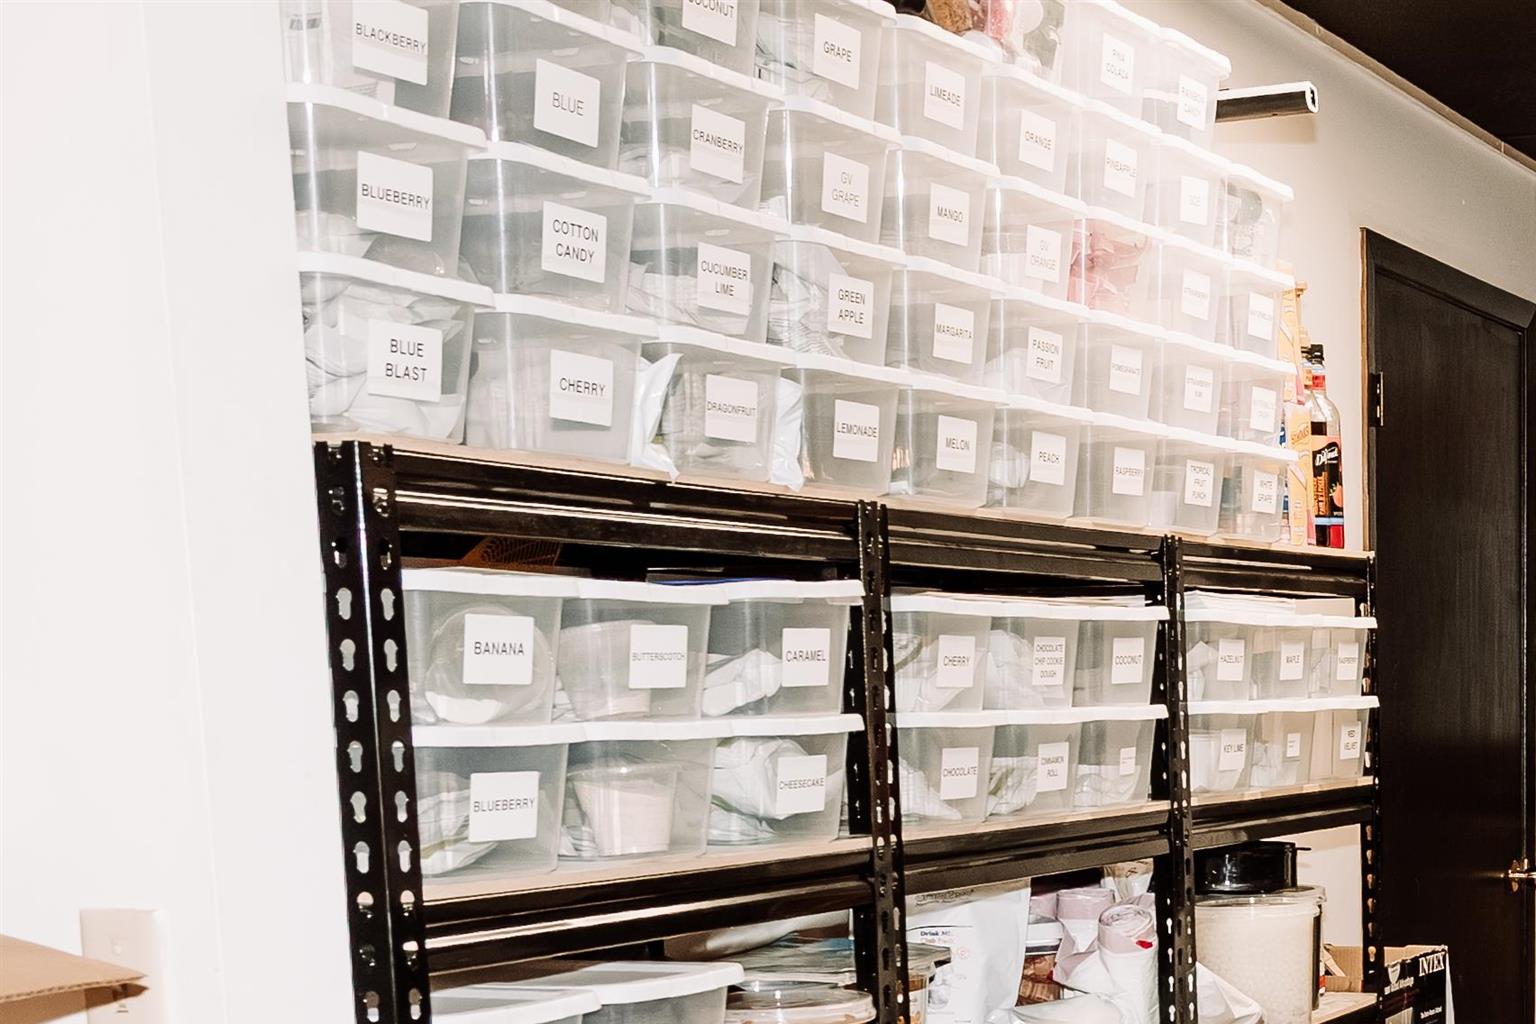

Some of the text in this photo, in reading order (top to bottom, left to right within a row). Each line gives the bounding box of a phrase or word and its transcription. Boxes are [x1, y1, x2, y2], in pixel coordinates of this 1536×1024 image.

[688, 0, 734, 18] CONUT
[355, 22, 426, 53] BLACKBERRY
[824, 41, 852, 63] GRAPE
[930, 84, 961, 107] LIMEADE
[552, 92, 584, 117] BLUE
[693, 129, 743, 153] CRANBERRY
[1025, 131, 1052, 150] ORANGE
[361, 184, 430, 210] BLUEBERRY
[832, 188, 860, 207] GRAPE
[937, 205, 964, 223] MANGO
[552, 218, 599, 242] COTTON
[555, 242, 595, 263] CANDY
[700, 260, 748, 280] CUCUMBER
[715, 282, 735, 297] LIME
[837, 288, 866, 305] GREEN
[838, 307, 865, 325] APPLE
[936, 323, 974, 340] MARGARITA
[389, 338, 425, 358] BLUE
[1032, 339, 1060, 356] PASSION
[1035, 356, 1055, 371] FRUIT
[385, 363, 428, 383] BLAST
[559, 377, 606, 397] CHERRY
[707, 401, 756, 417] DRAGONFRUIT
[836, 422, 879, 438] LEMONADE
[945, 437, 970, 451] MELON
[1038, 450, 1061, 466] PEACH
[474, 640, 524, 656] BANANA
[1036, 643, 1063, 652] CHOCOLATE
[631, 651, 686, 663] BUTTERSCOTCH
[785, 650, 827, 663] CARAMEL
[943, 656, 970, 667] CHERRY
[1115, 654, 1142, 666] COCONUT
[943, 766, 977, 778] CHOCOLATE
[778, 778, 825, 791] CHEESECAKE
[473, 798, 535, 813] BLUEBERRY
